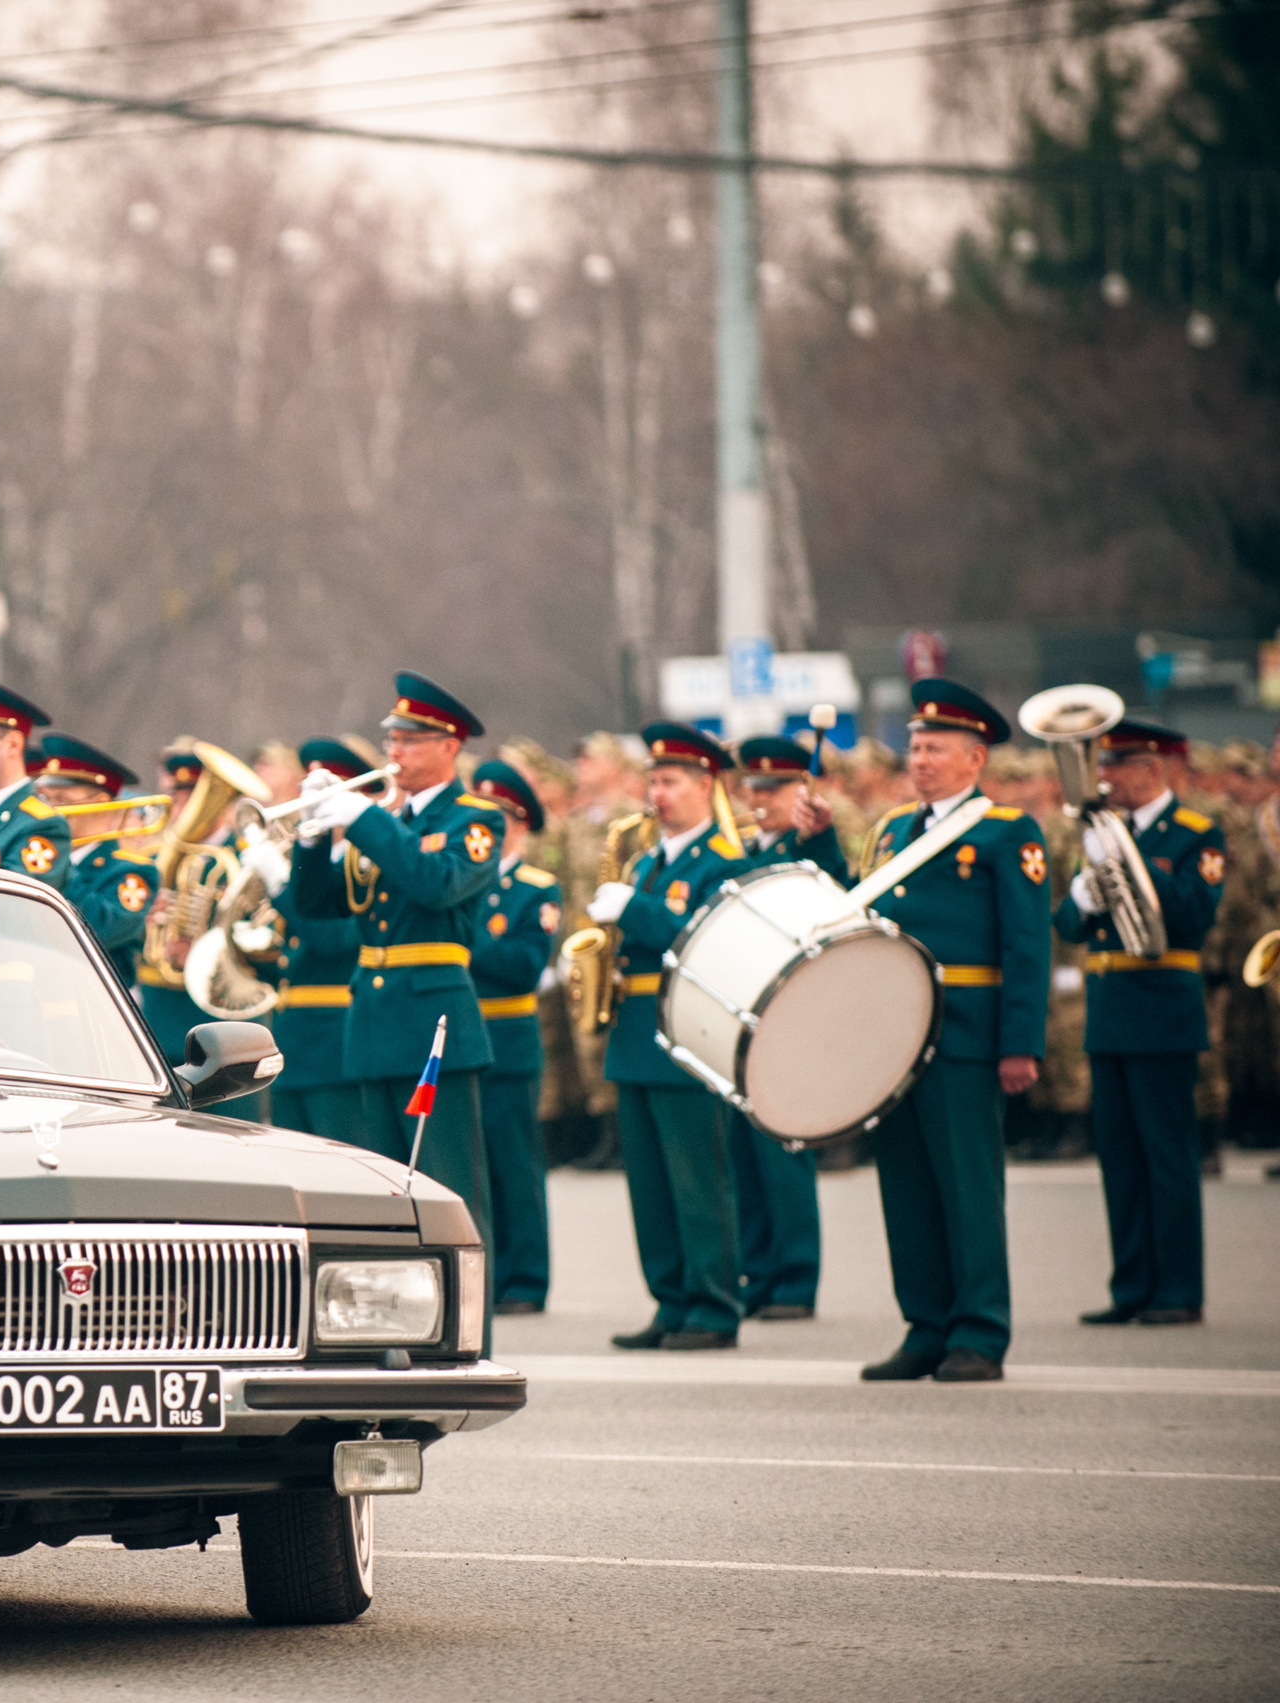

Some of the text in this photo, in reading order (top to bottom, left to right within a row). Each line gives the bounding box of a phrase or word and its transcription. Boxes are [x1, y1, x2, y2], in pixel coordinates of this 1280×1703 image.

[93, 1385, 151, 1424] AA
[163, 1372, 207, 1410] 87
[170, 1411, 203, 1425] RUS
